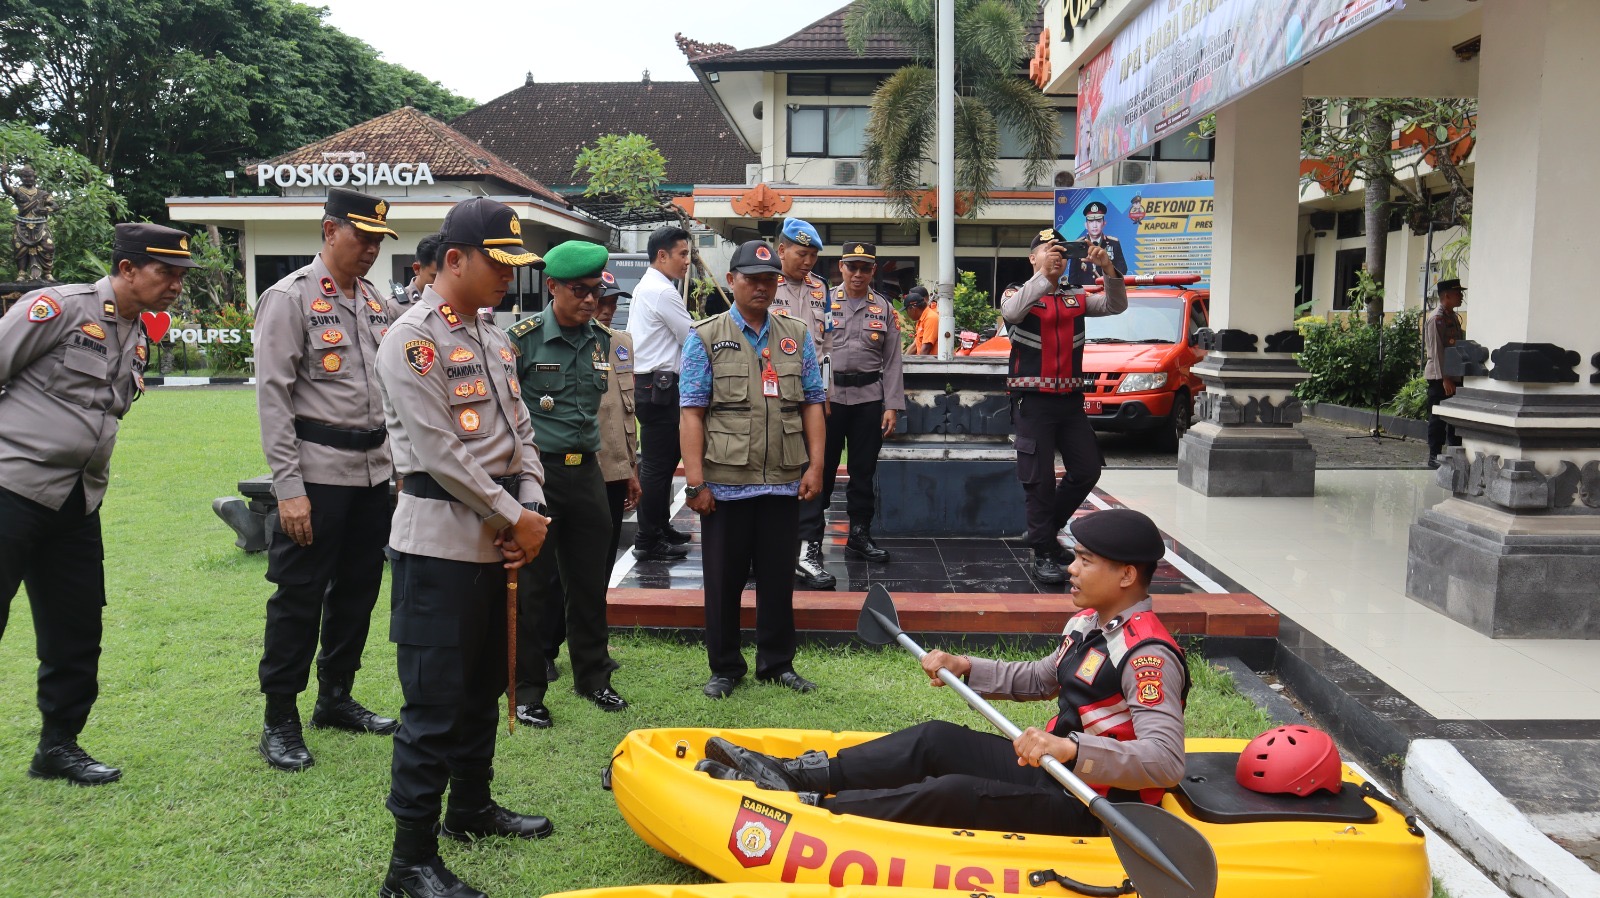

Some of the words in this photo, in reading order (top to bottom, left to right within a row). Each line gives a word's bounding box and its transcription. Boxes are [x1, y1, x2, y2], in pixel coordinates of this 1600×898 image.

[257, 163, 350, 188] POSKO
[350, 162, 435, 187] SIAGA
[1146, 200, 1196, 213] BEYOND
[1199, 199, 1214, 213] TR
[1144, 221, 1179, 231] KAPOLRI
[1194, 220, 1213, 229] PRES
[310, 315, 341, 326] SURYA
[864, 313, 886, 322] POLRI
[246, 329, 255, 344] T
[713, 341, 739, 350] ASTAWA
[446, 364, 476, 379] CHANDRA
[743, 799, 787, 823] SABHARA
